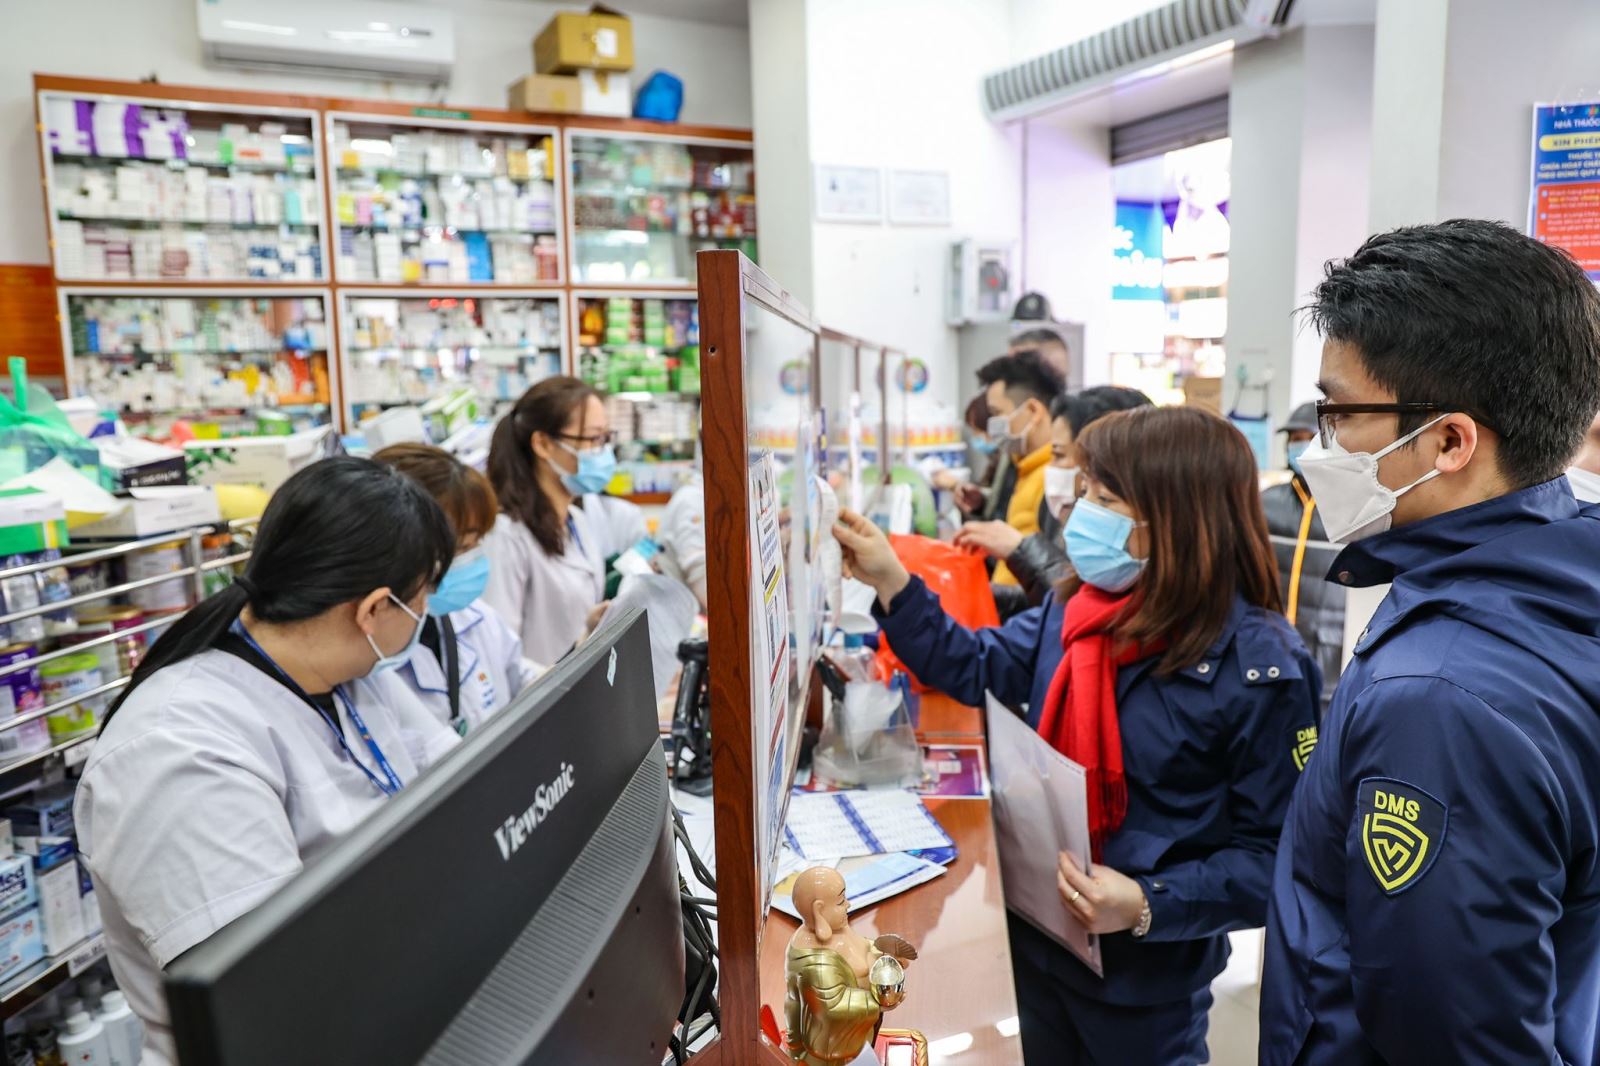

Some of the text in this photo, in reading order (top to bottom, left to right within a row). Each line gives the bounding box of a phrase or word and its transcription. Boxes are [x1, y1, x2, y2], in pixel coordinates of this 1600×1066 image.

[1297, 726, 1317, 741] DM
[494, 762, 575, 862] ViewSonic
[1374, 790, 1420, 821] DMS
